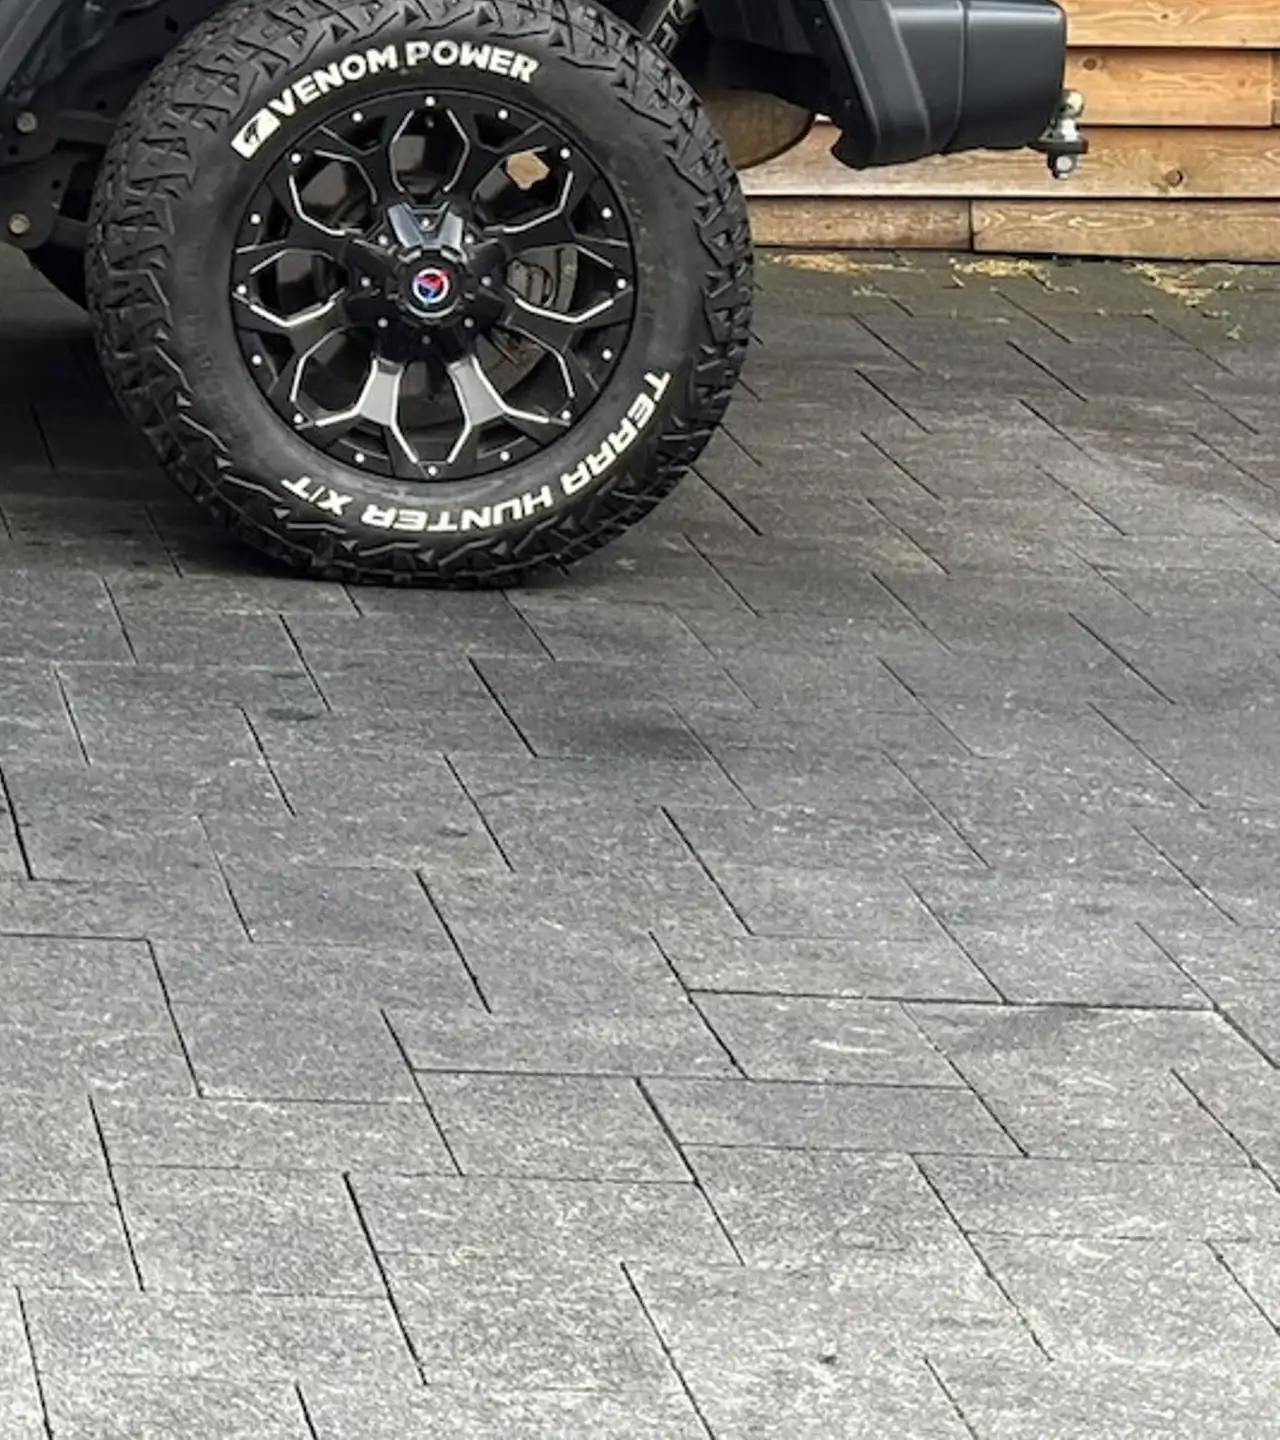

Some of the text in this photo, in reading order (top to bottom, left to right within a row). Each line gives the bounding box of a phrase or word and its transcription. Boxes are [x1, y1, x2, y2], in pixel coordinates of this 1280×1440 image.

[271, 39, 540, 118] VENOM POWER
[281, 369, 673, 533] TERRA HUNTER X/T
